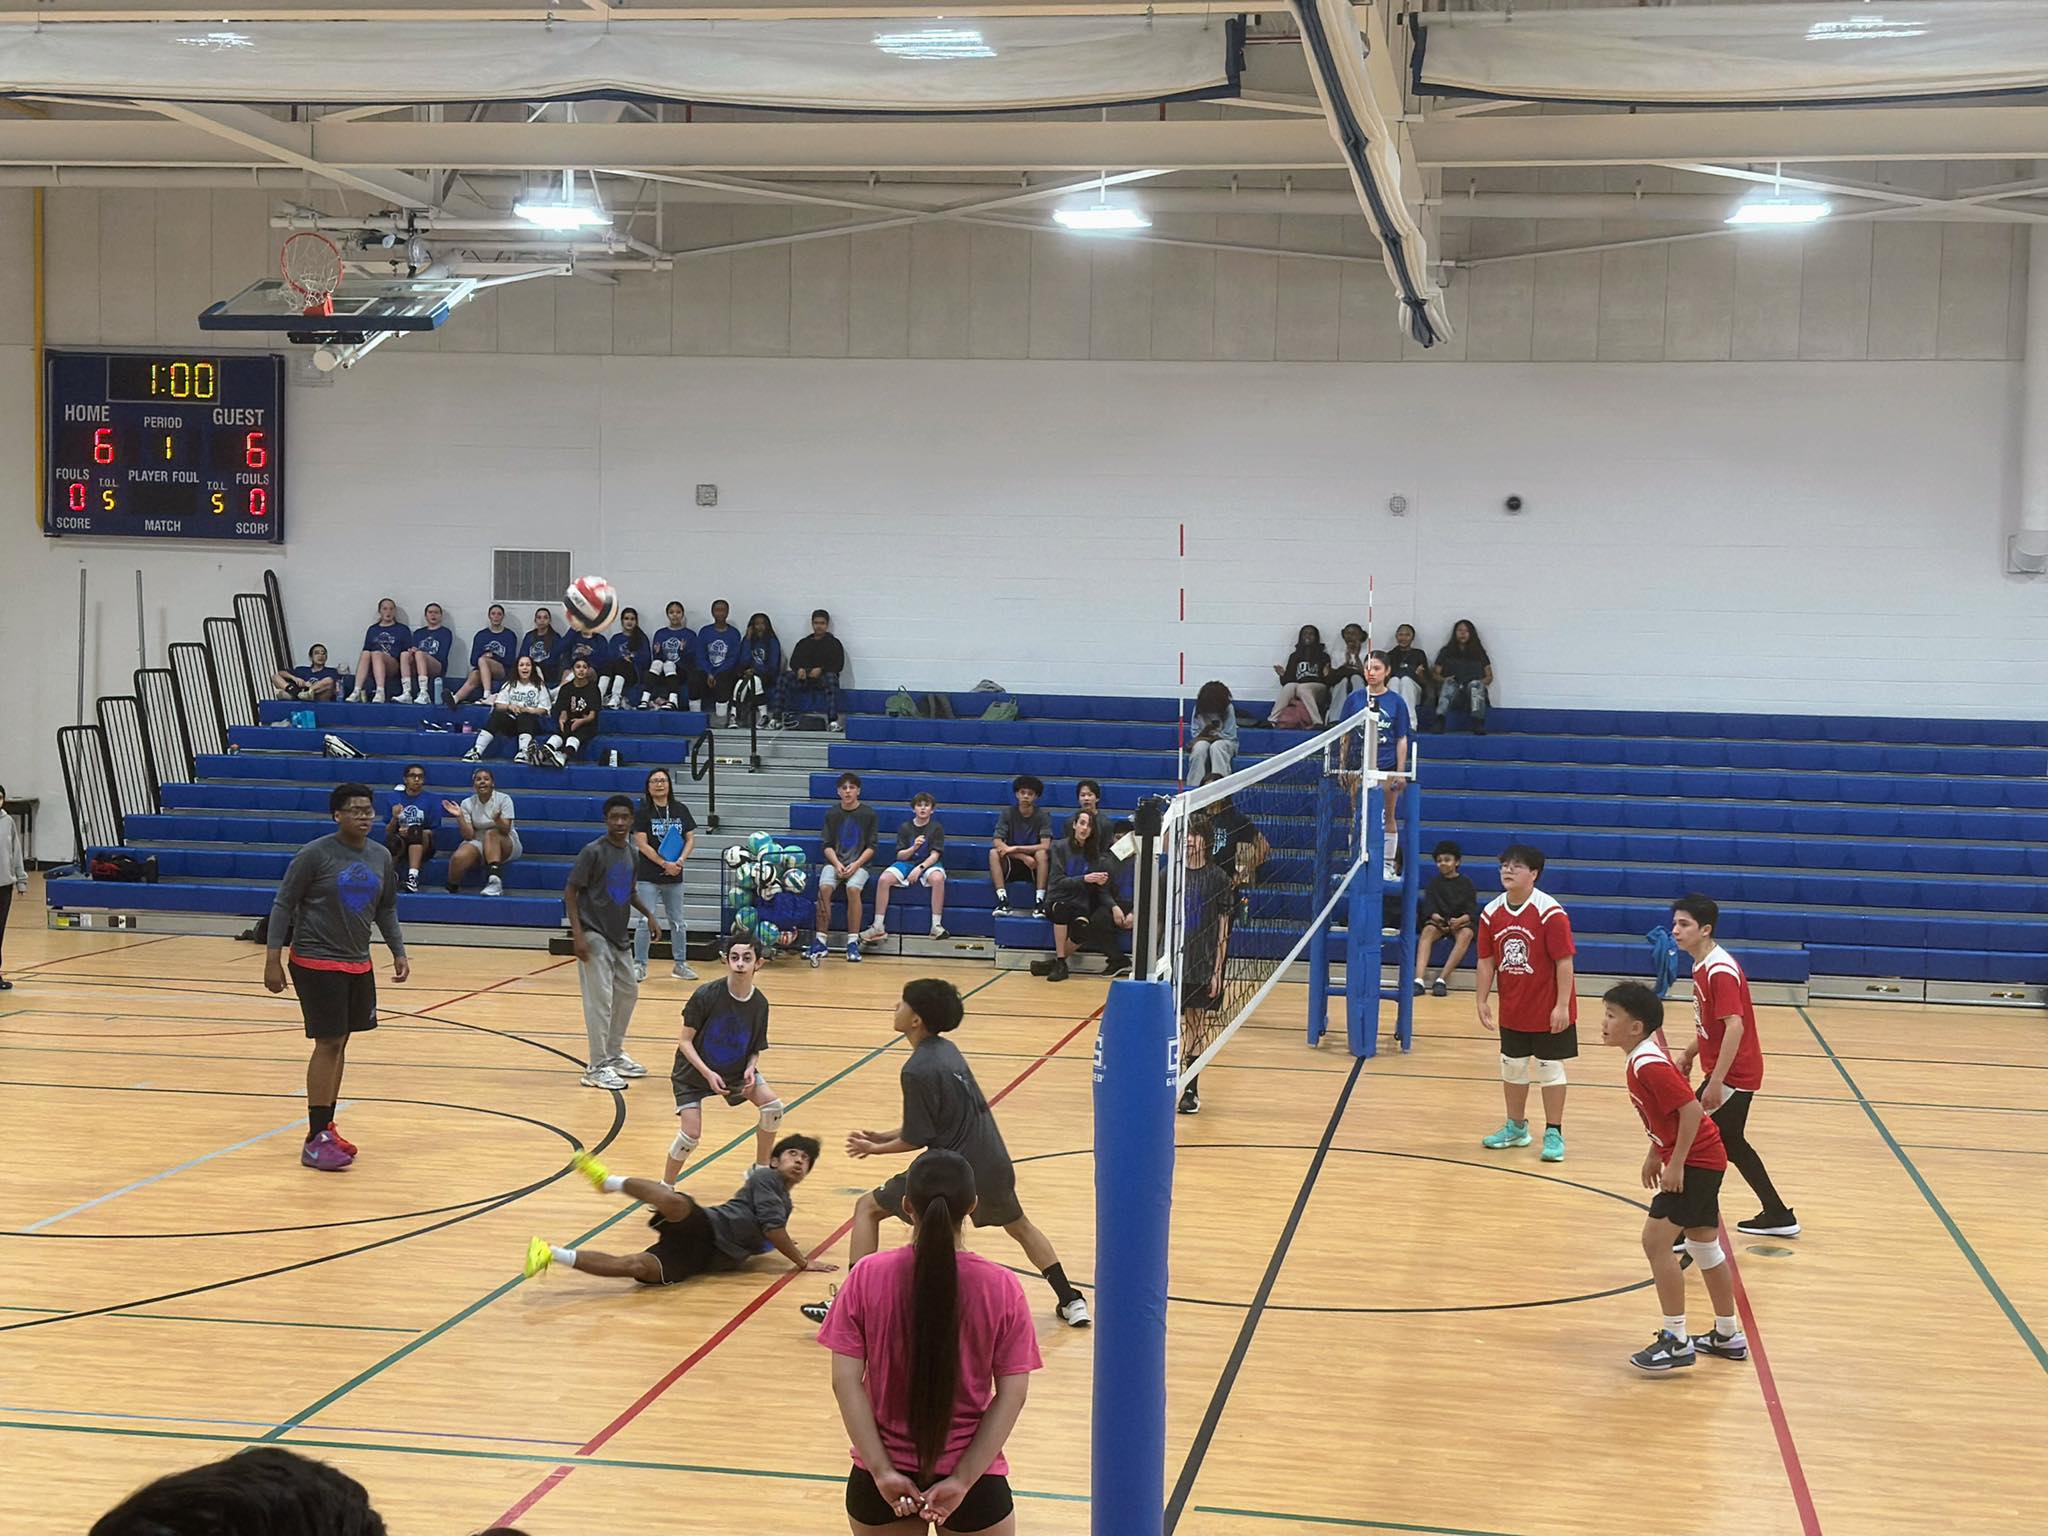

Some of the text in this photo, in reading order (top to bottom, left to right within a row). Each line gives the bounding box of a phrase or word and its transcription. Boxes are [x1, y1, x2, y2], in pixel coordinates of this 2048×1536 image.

[151, 363, 213, 398] 1:00
[64, 405, 110, 422] HOME
[143, 416, 183, 429] PERIOD
[212, 408, 264, 426] GUEST
[94, 428, 114, 464] 6
[246, 432, 266, 468] 6
[56, 468, 90, 480] FOULS
[128, 470, 200, 483] PLAYER FOUL
[235, 473, 270, 485] FOULS
[69, 483, 86, 511] 0
[102, 490, 115, 511] 5
[211, 493, 224, 514] 5
[249, 488, 266, 515] 0
[56, 517, 91, 529] SCORE
[144, 519, 181, 532] MATCH
